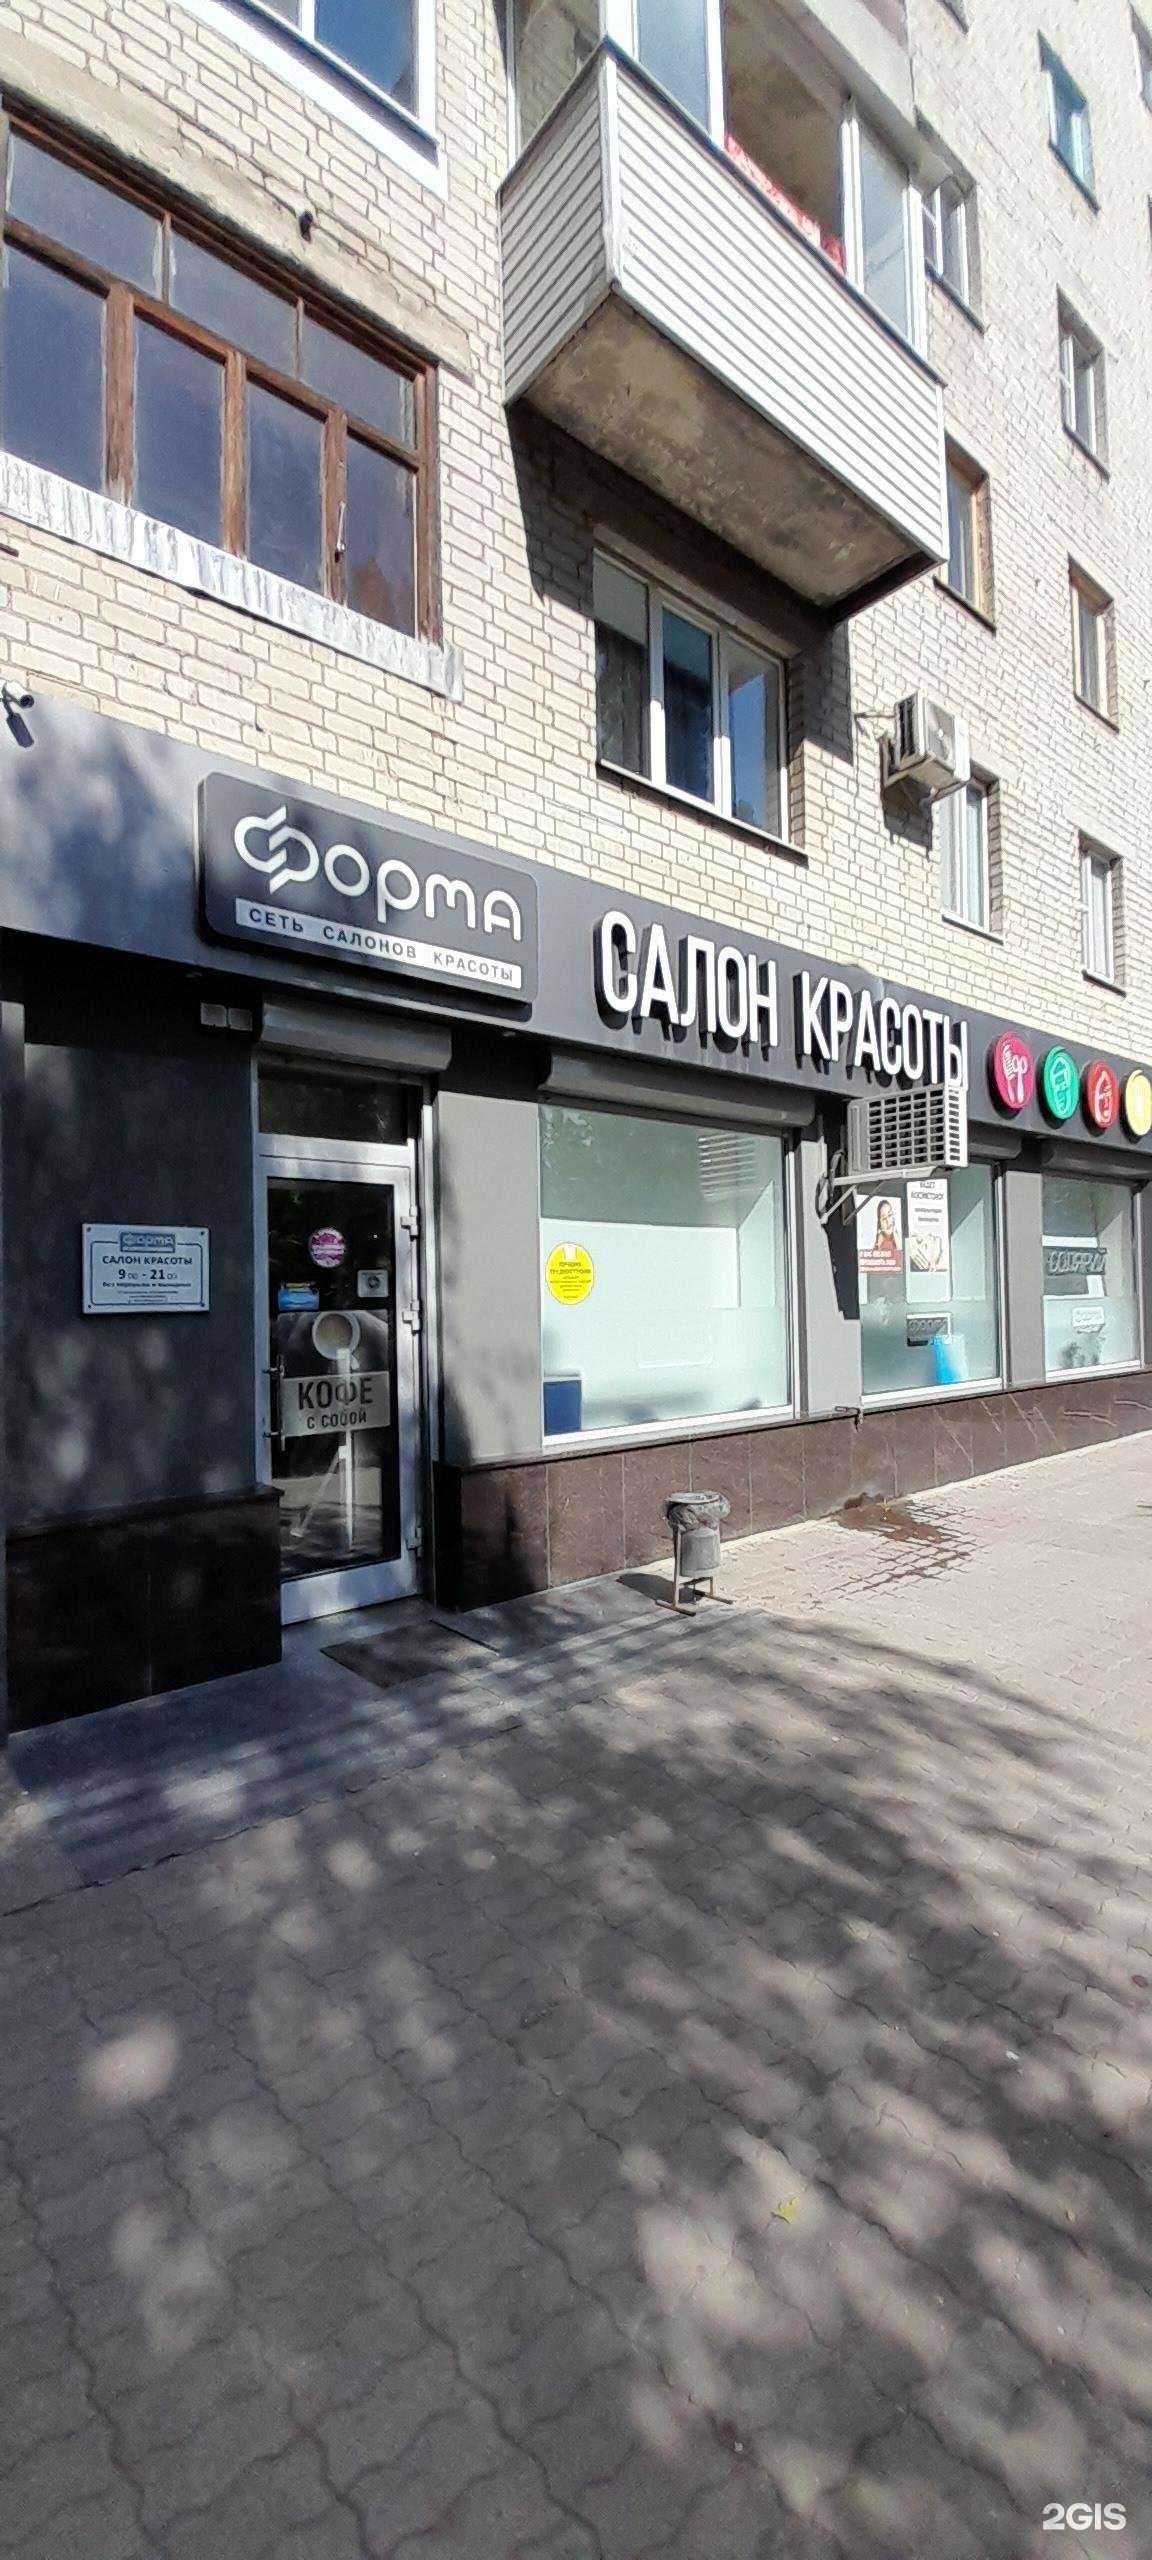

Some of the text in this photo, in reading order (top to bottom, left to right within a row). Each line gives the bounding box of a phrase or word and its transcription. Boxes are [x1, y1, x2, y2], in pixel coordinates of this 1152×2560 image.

[249, 908, 514, 982] СЕТЬ САЛОНОВ КРАСОТЫ
[596, 909, 969, 1091] САЛОН КРАСОТЫ
[102, 1255, 193, 1265] САЛОН КРАСОТЫ
[298, 1376, 374, 1410] КОФЕ
